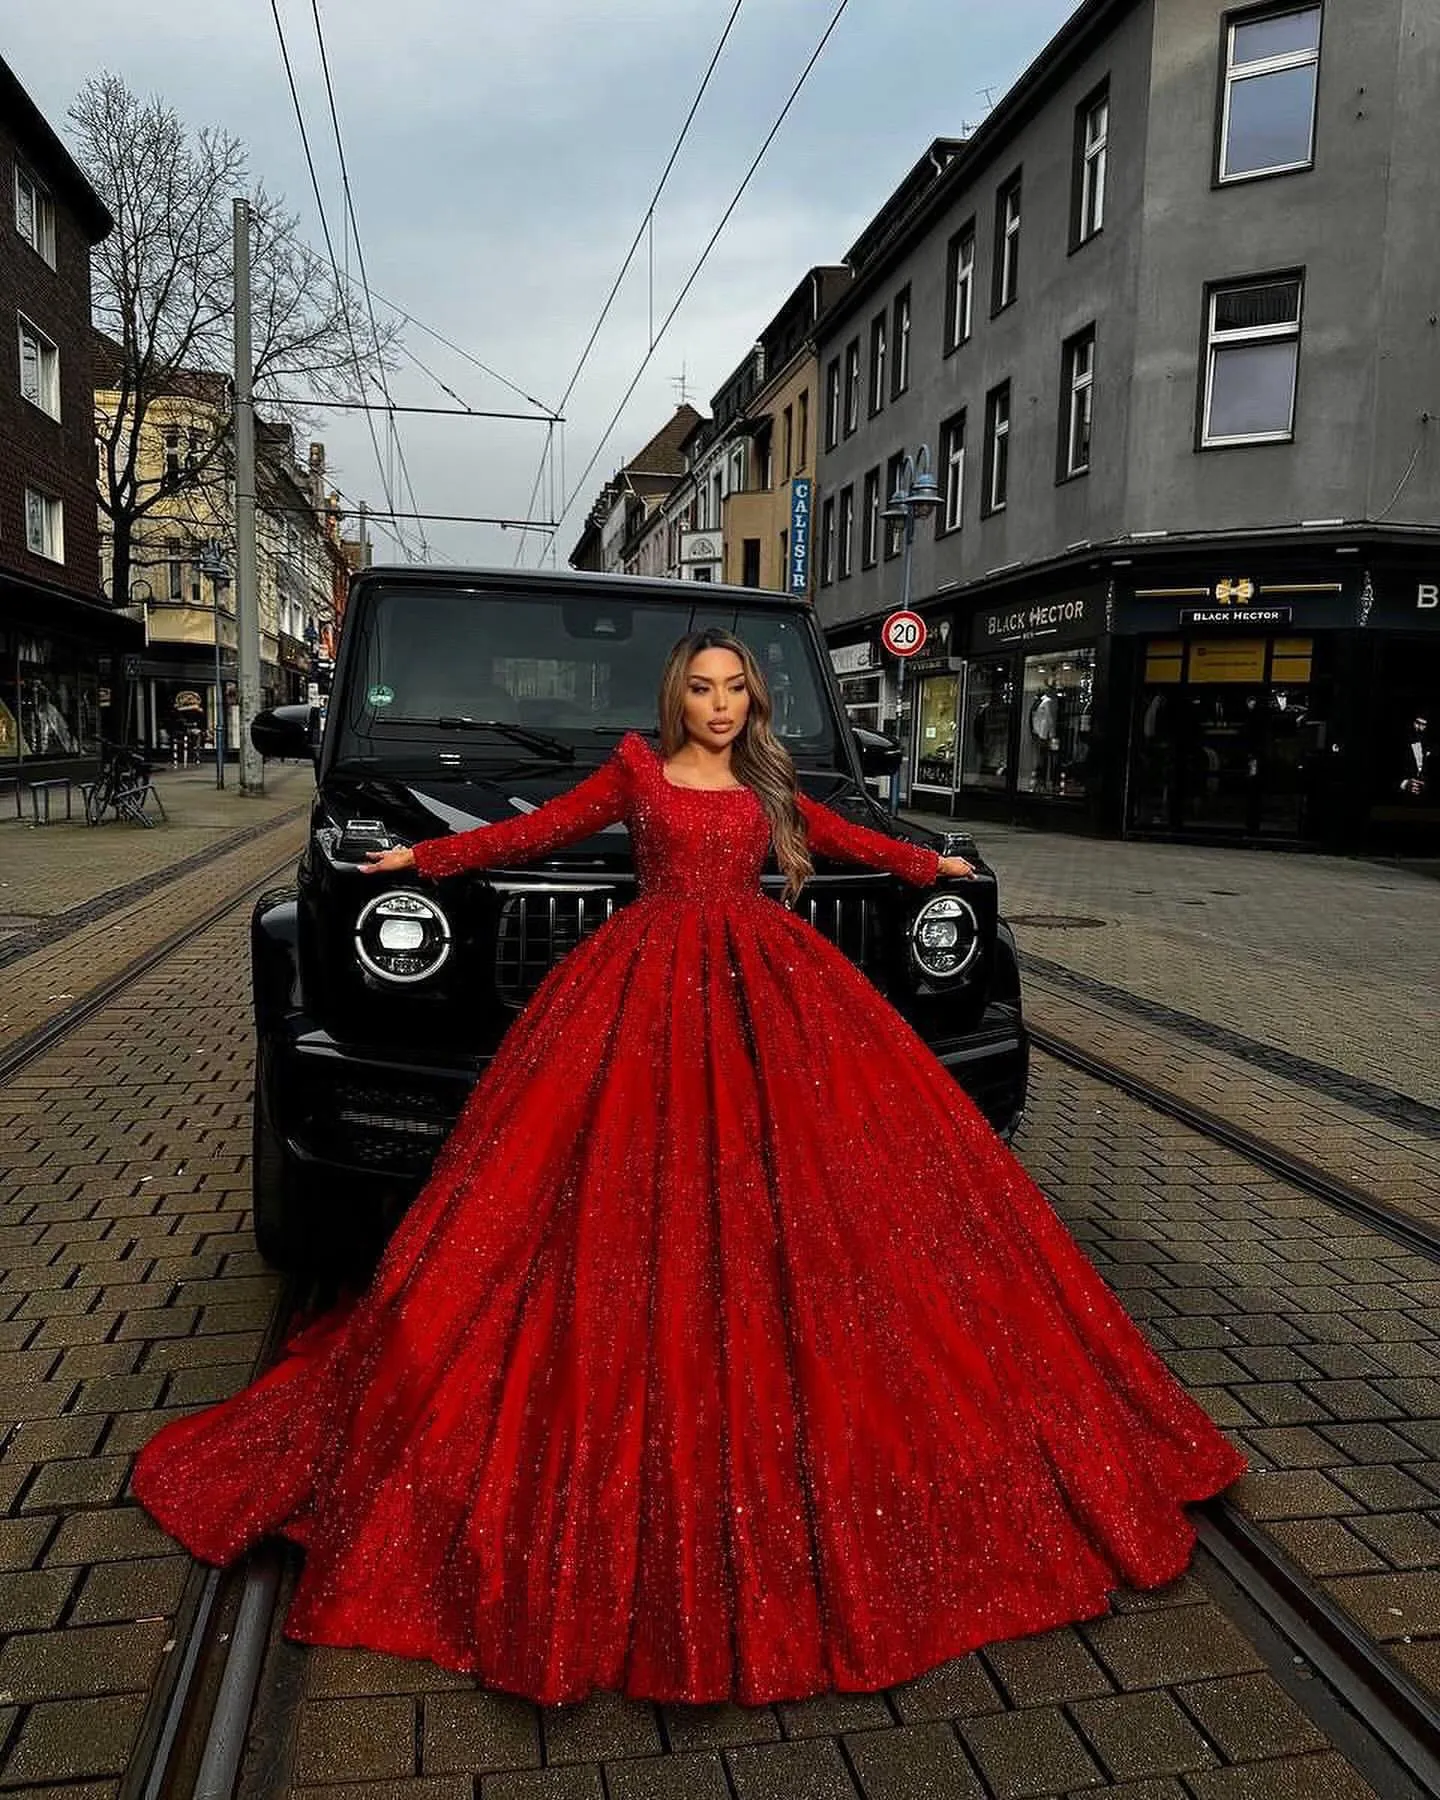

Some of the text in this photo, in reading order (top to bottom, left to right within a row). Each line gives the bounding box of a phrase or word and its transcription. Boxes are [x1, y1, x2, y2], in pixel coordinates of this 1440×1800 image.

[793, 484, 809, 587] CALISIR
[988, 600, 1085, 635] BLACK HECTOR
[1193, 611, 1279, 621] BLACK HECTOR
[893, 623, 917, 644] 20
